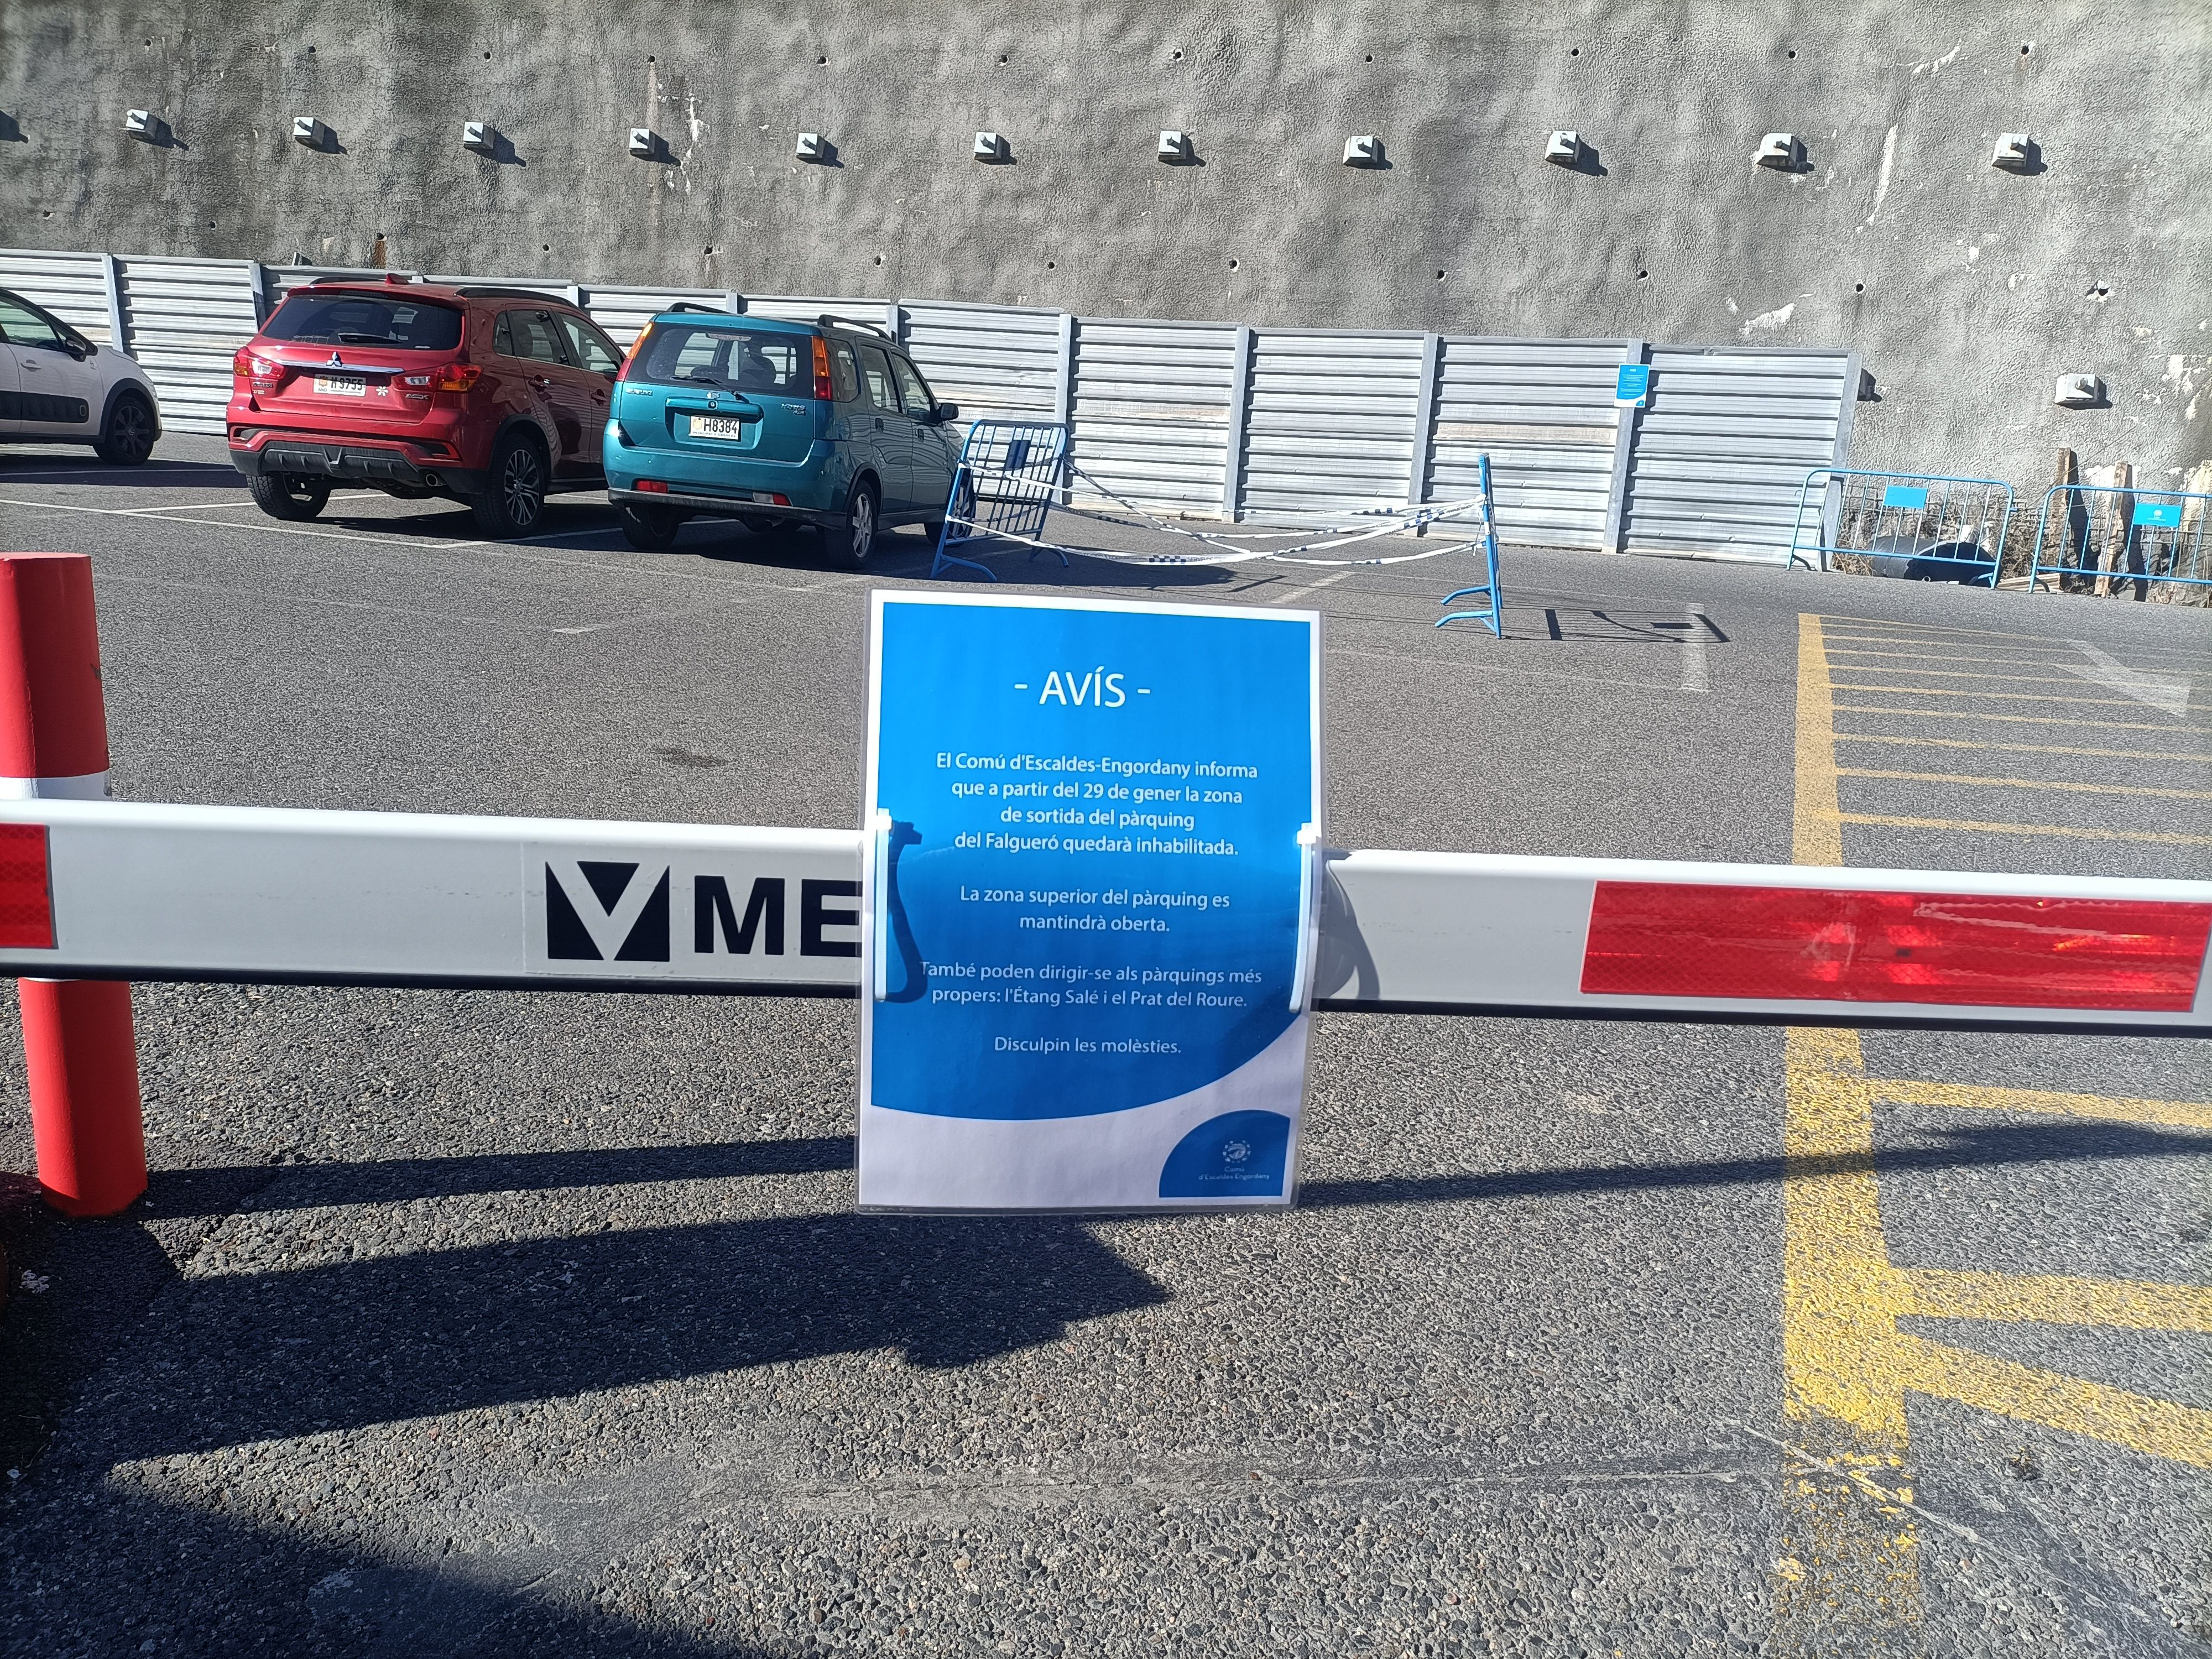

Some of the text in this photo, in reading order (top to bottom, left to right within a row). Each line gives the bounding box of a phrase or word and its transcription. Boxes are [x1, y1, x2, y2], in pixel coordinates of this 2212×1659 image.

[703, 418, 737, 434] H8384
[1039, 665, 1126, 708] AVÍS
[937, 752, 1258, 780] El Comú d'Escaldes-Engordany informa
[951, 781, 1243, 804] que a partir del 29 de gener la zona
[1000, 805, 1194, 832] de sortida del pàrquing
[954, 831, 1239, 855] del Falgueró quedarà inhabilitada.
[961, 885, 1230, 911] La zona superior del pàrquing es
[1020, 914, 1170, 932] mantindrà oberta.
[920, 961, 1262, 986] També poden dirigir-se als pàrquings més
[932, 985, 1247, 1007] propers: l'Étang Salé i el Prat del Roure.
[994, 1036, 1181, 1055] Disculpin les molèsties.
[1234, 1172, 1270, 1181] Engordany
